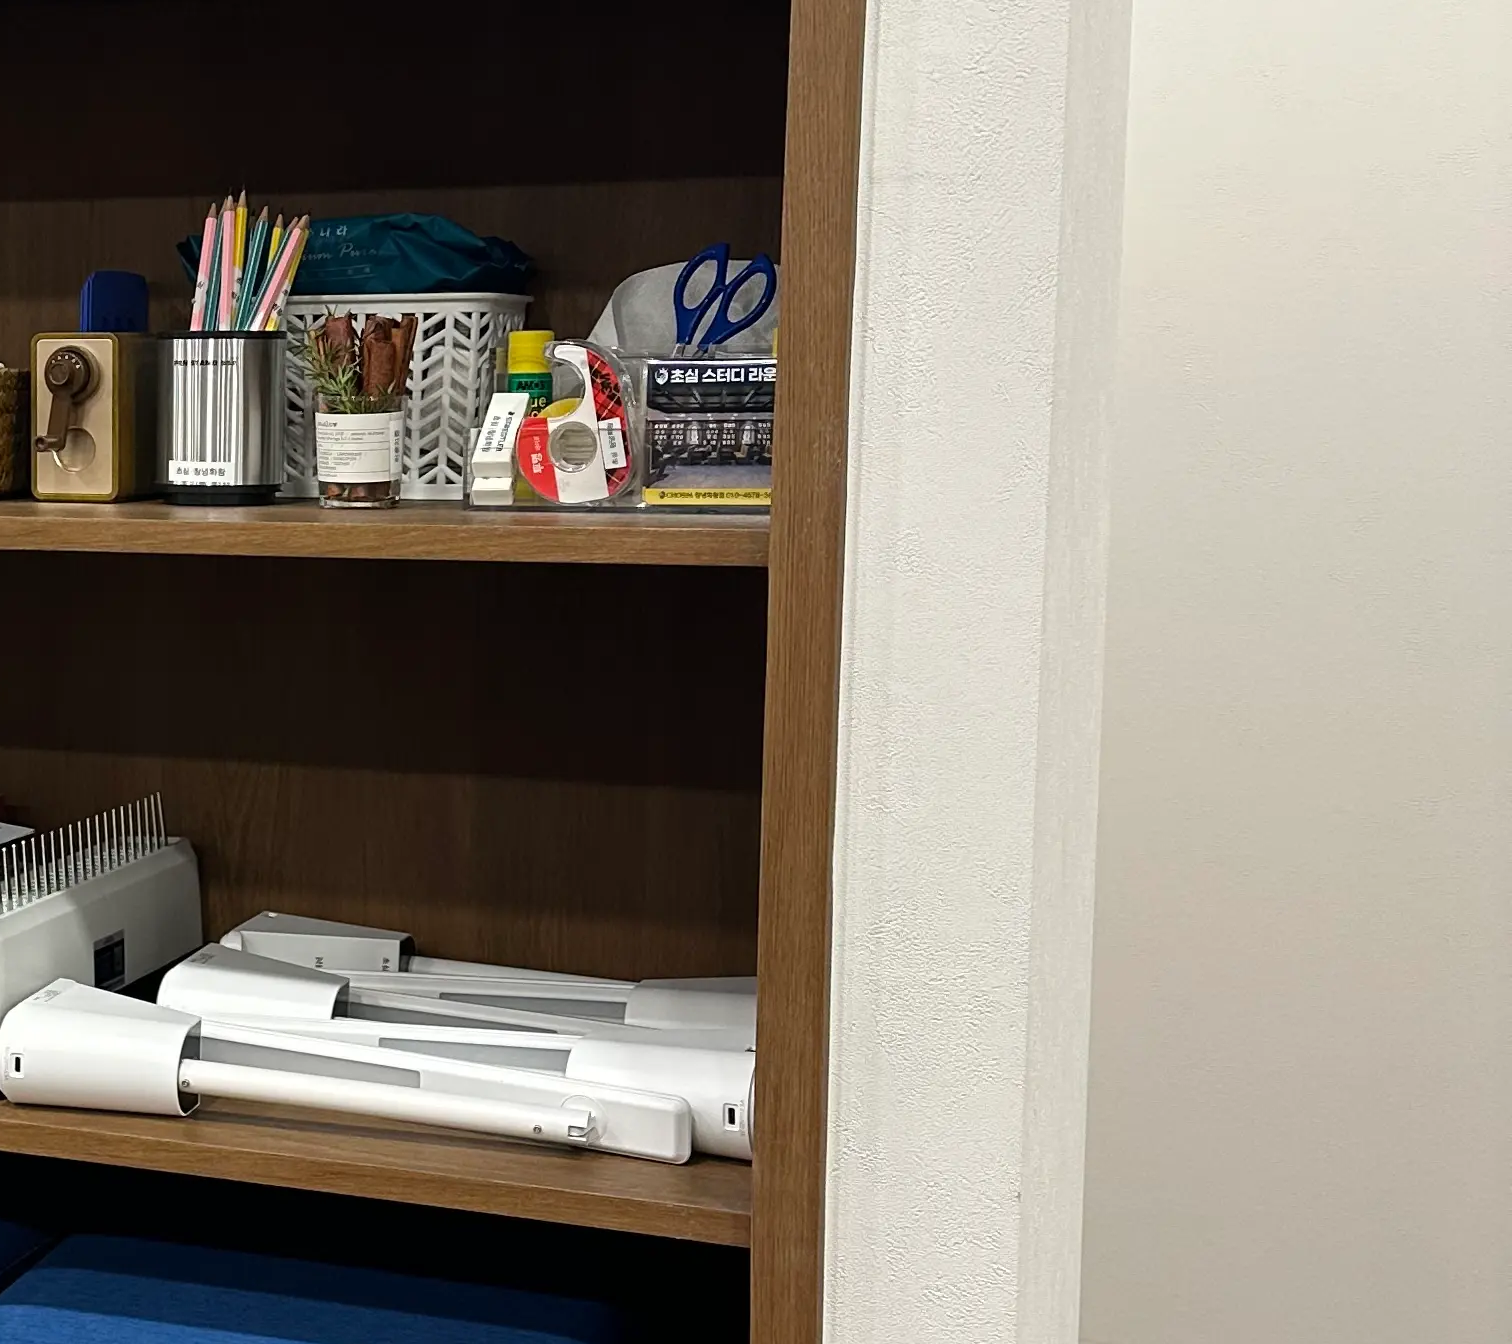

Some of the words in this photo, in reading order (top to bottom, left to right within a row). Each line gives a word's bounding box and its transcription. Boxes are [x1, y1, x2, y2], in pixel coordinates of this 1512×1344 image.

[670, 368, 699, 383] 초심
[701, 367, 745, 383] 스터디
[748, 367, 777, 382] 라운
